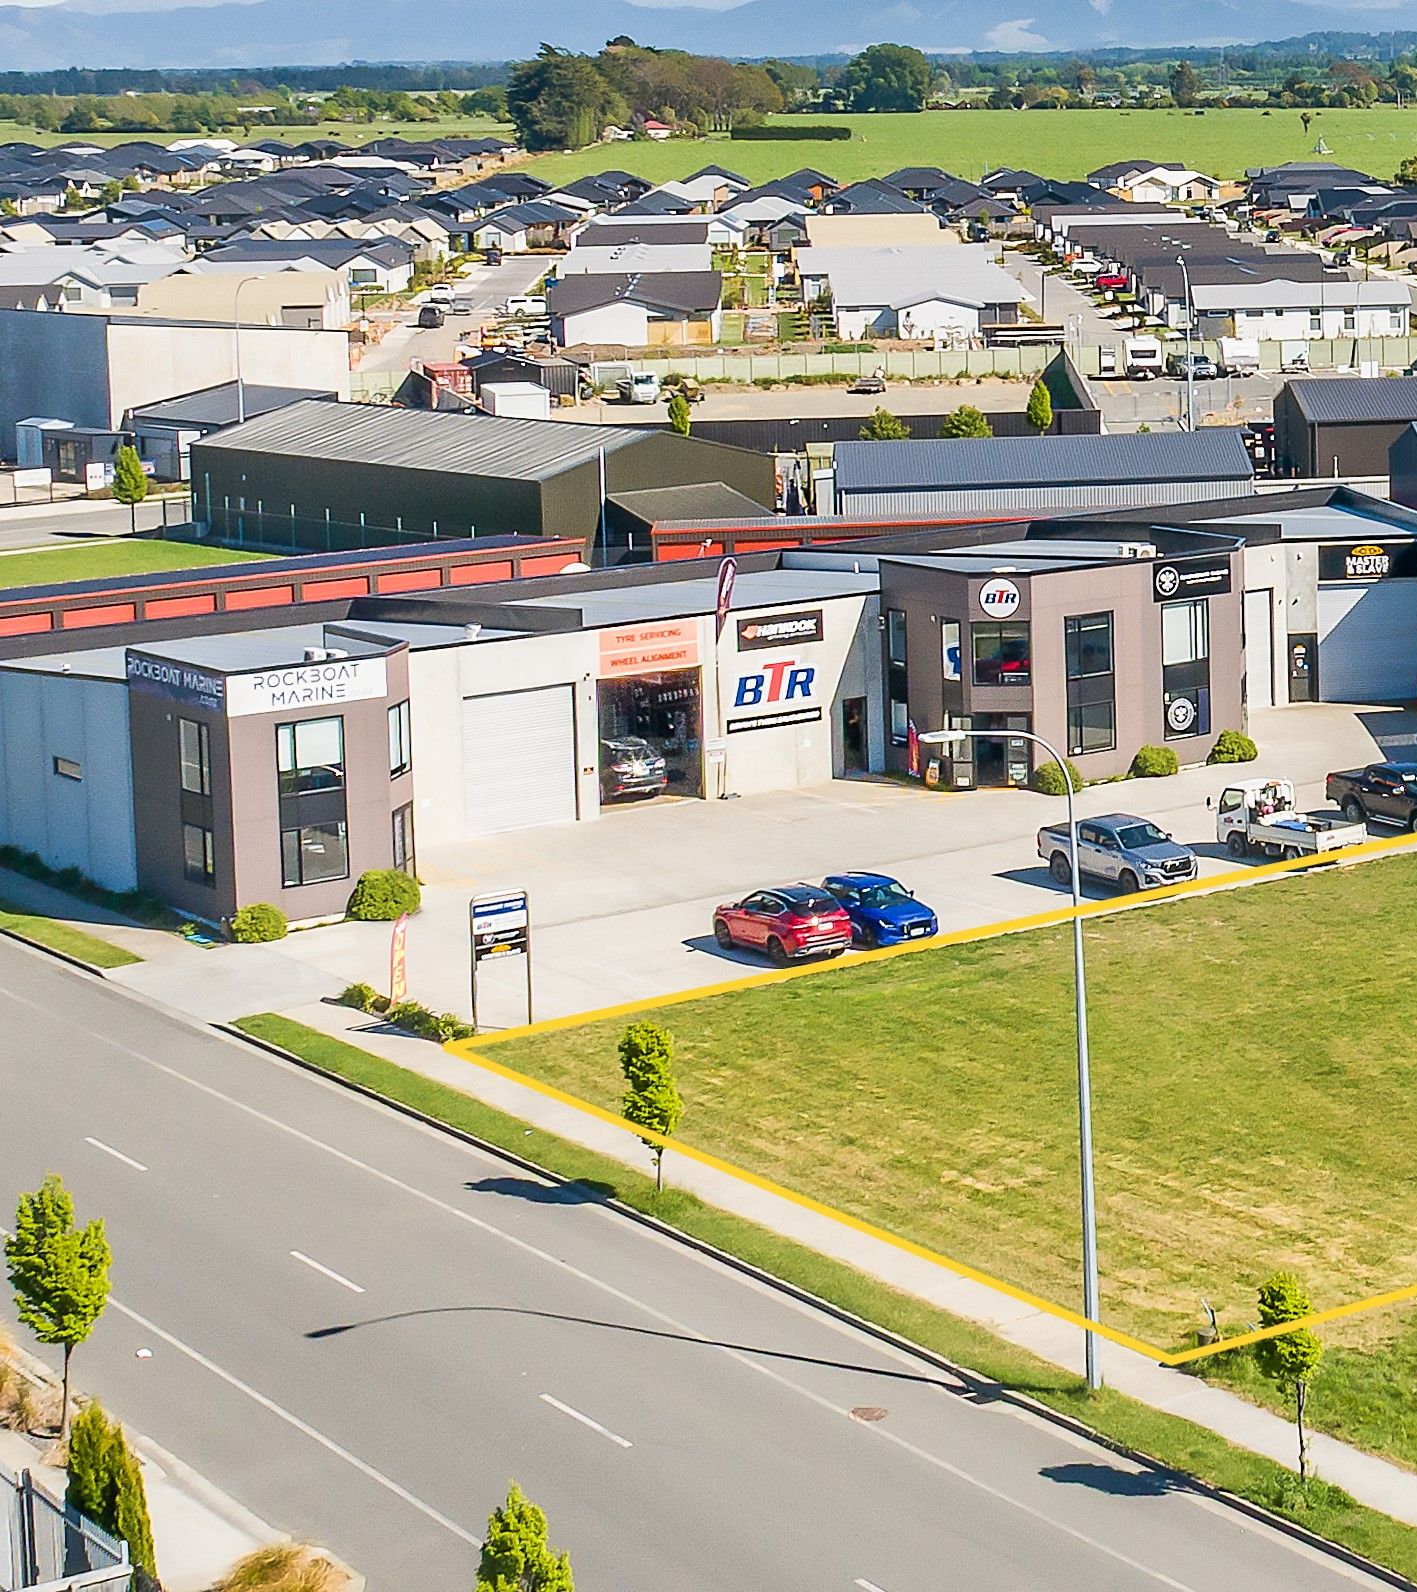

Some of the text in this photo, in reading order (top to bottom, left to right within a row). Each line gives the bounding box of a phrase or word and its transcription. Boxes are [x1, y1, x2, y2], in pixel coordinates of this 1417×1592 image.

[1345, 555, 1390, 567] MASTER
[1356, 563, 1389, 575] SLAVE
[984, 589, 1017, 604] BTR
[615, 628, 682, 644] TYRE SERVICING
[610, 650, 688, 667] WHEEL ALIGNMENT
[253, 663, 360, 690] ROCKBOAT
[733, 660, 816, 707] BTR
[271, 683, 346, 706] MARINE
